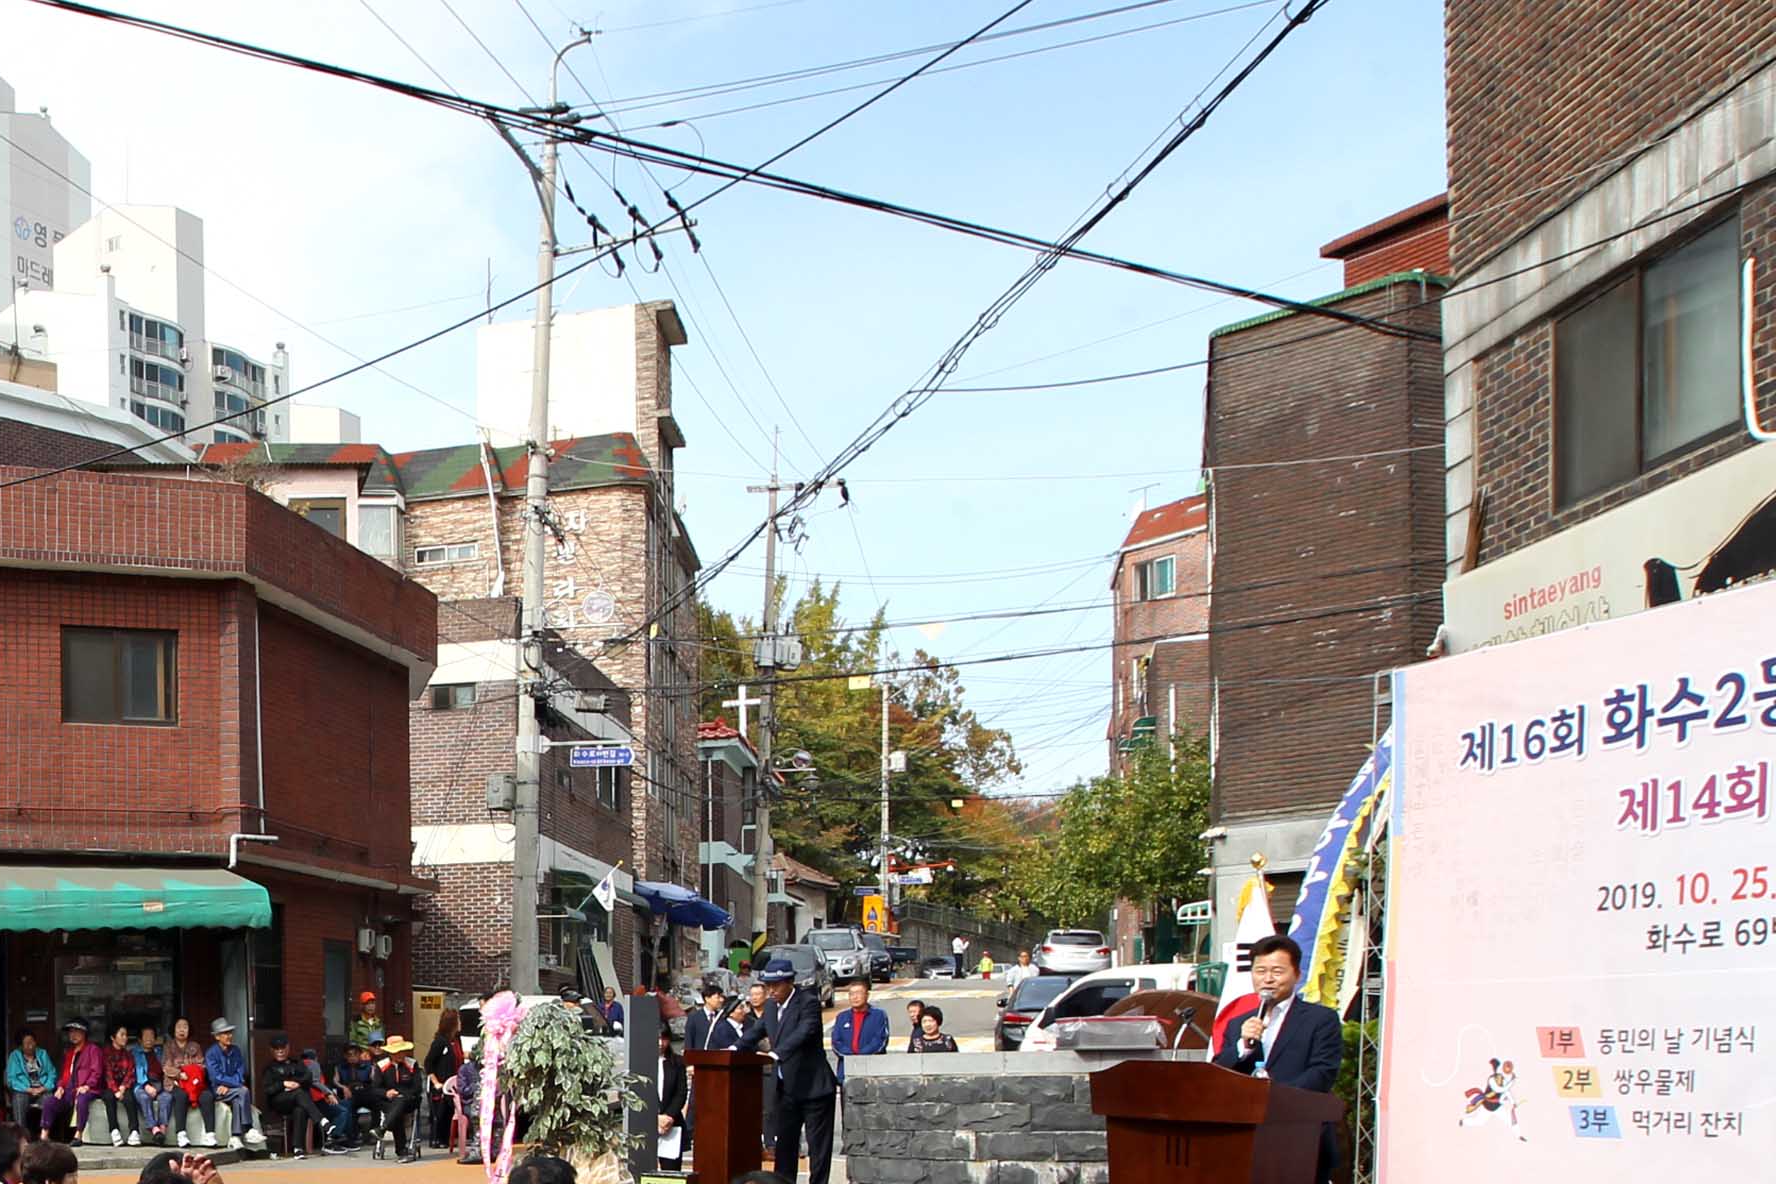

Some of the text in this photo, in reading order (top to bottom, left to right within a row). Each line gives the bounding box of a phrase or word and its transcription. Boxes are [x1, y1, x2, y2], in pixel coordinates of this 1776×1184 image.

[1503, 565, 1602, 621] sintaeyang
[1460, 704, 1585, 771] 제16회
[1617, 761, 1769, 832] 제14회
[1597, 881, 1662, 912] 2019.
[1676, 872, 1717, 905] 10.
[1646, 917, 1776, 954] 화수로 69
[1547, 1026, 1756, 1055] 1부 동민의 날 기념식
[1563, 1068, 1695, 1096] 2부 쌍우물제
[1579, 1109, 1743, 1138] 3부 먹거리 잔치
